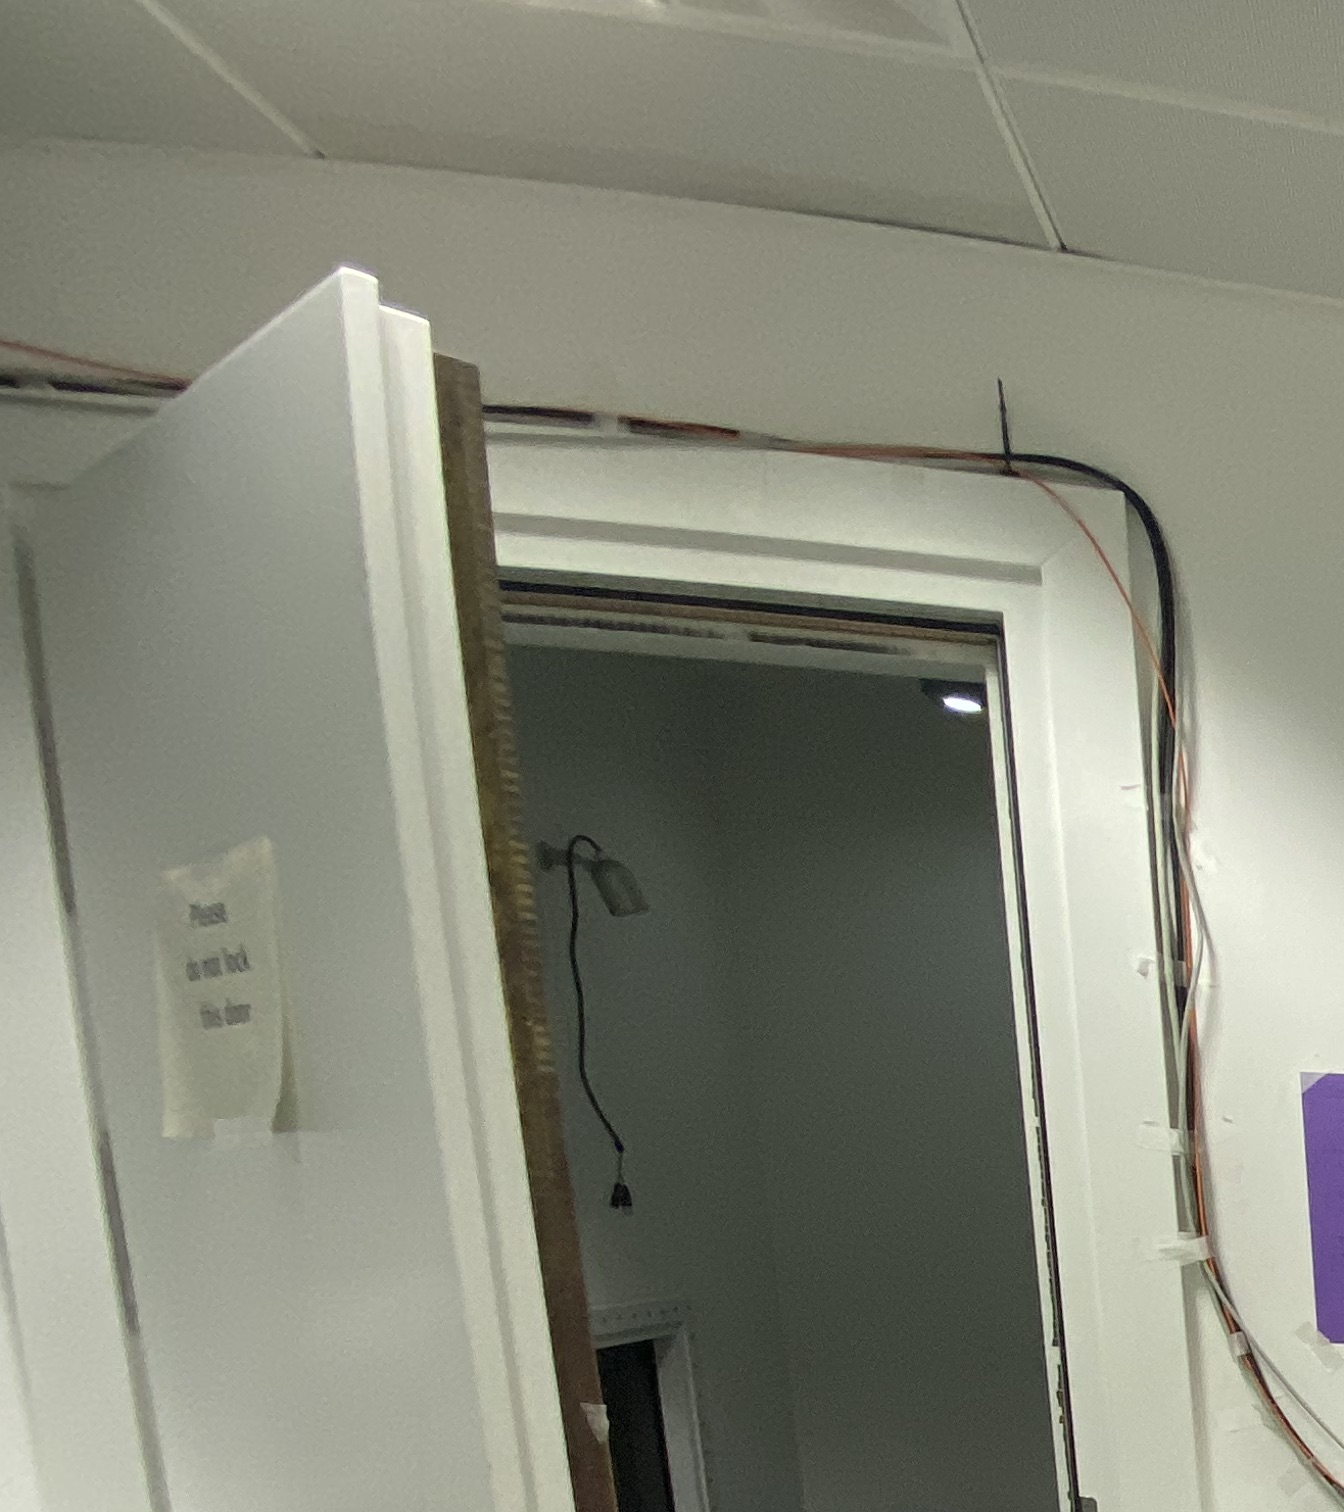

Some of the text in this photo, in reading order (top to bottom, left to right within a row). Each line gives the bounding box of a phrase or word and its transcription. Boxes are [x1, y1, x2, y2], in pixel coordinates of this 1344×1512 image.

[188, 902, 228, 927] Please
[221, 943, 251, 973] lock
[225, 997, 252, 1025] door
